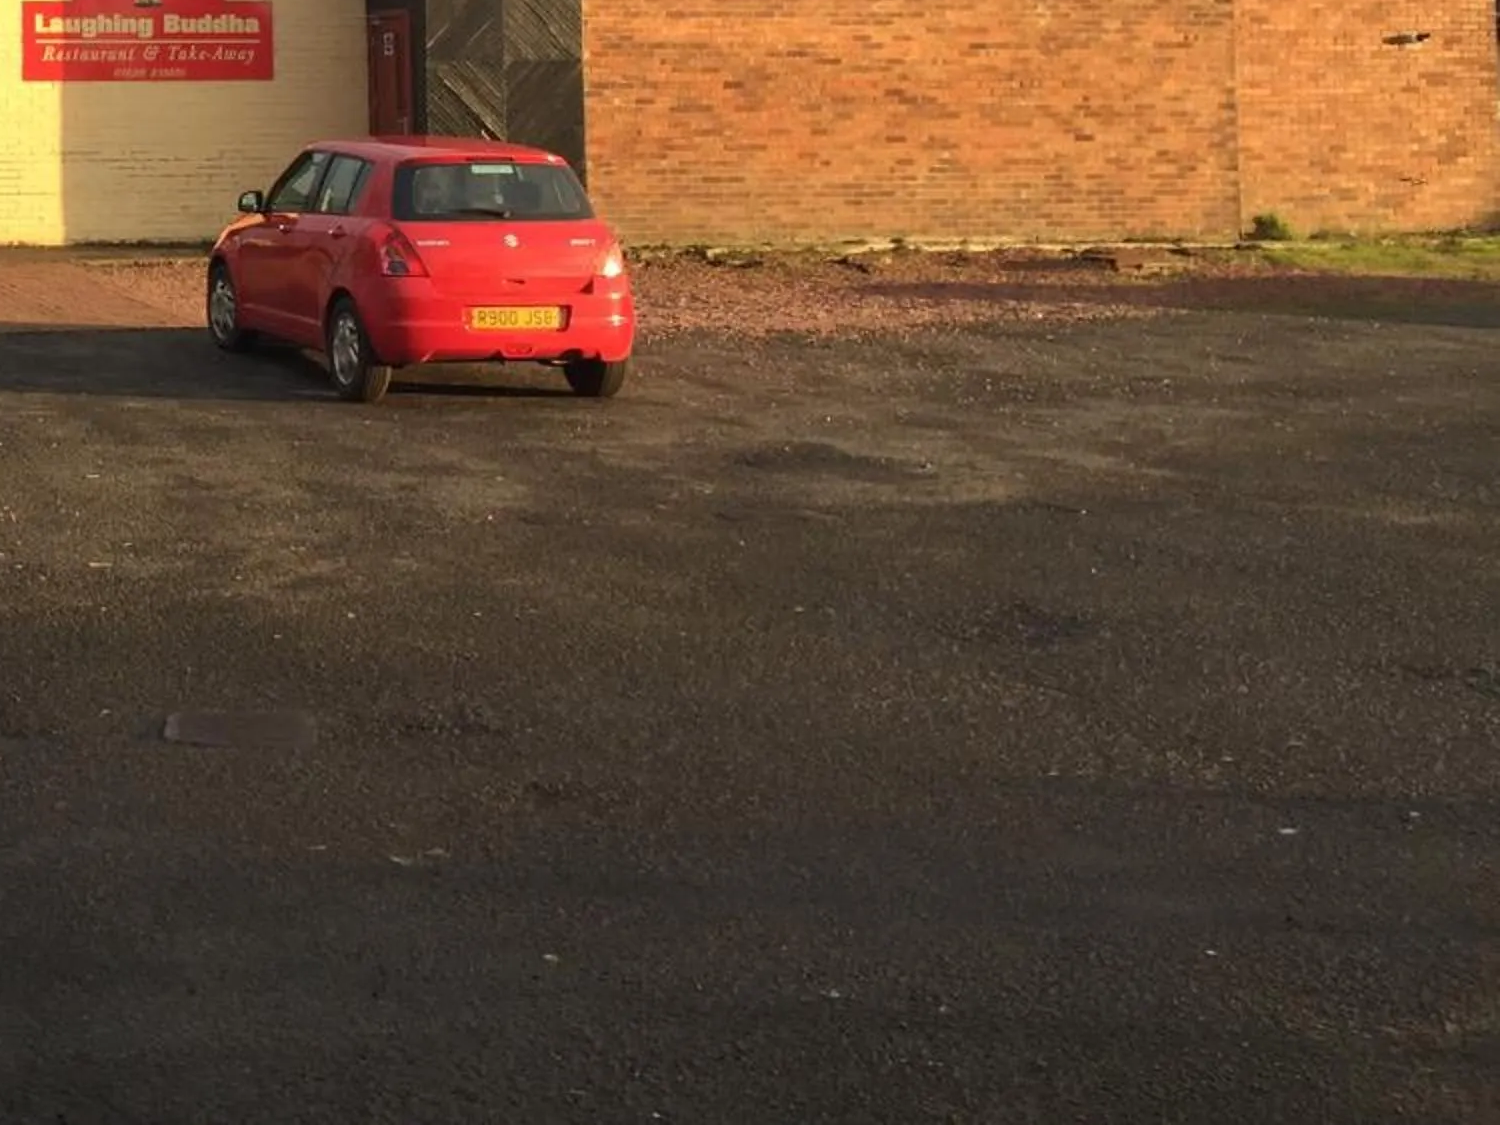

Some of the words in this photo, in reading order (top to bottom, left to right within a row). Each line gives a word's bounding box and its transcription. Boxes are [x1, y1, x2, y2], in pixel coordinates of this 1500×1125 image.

[35, 13, 154, 38] Laughing
[163, 13, 260, 34] Buddha
[41, 45, 135, 62] Restaurant
[143, 45, 161, 61] &
[168, 45, 256, 64] Take-Away
